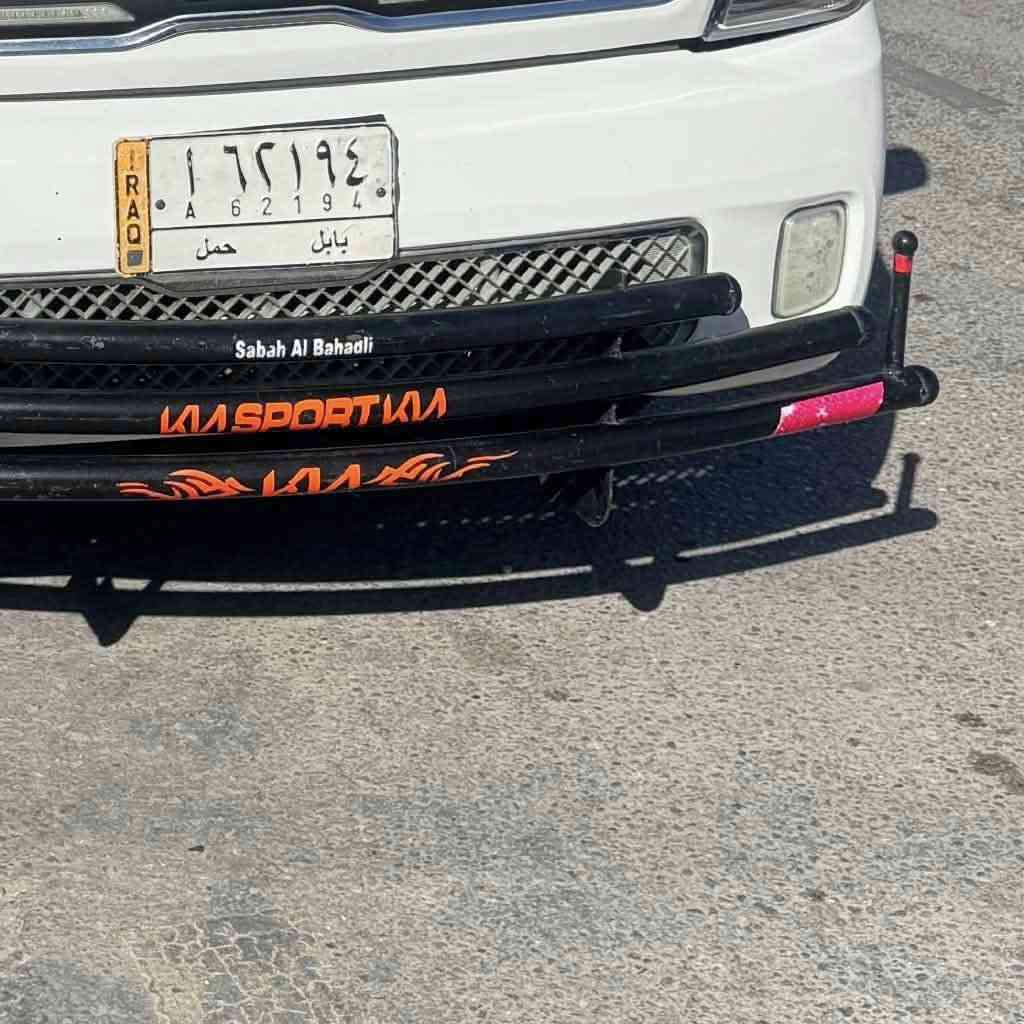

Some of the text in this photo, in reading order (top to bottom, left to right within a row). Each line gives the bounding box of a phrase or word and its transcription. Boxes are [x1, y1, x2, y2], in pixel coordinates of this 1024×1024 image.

[184, 201, 196, 219] A
[195, 229, 349, 260] بابل حمل
[235, 336, 374, 359] Sabah Al Bahadli
